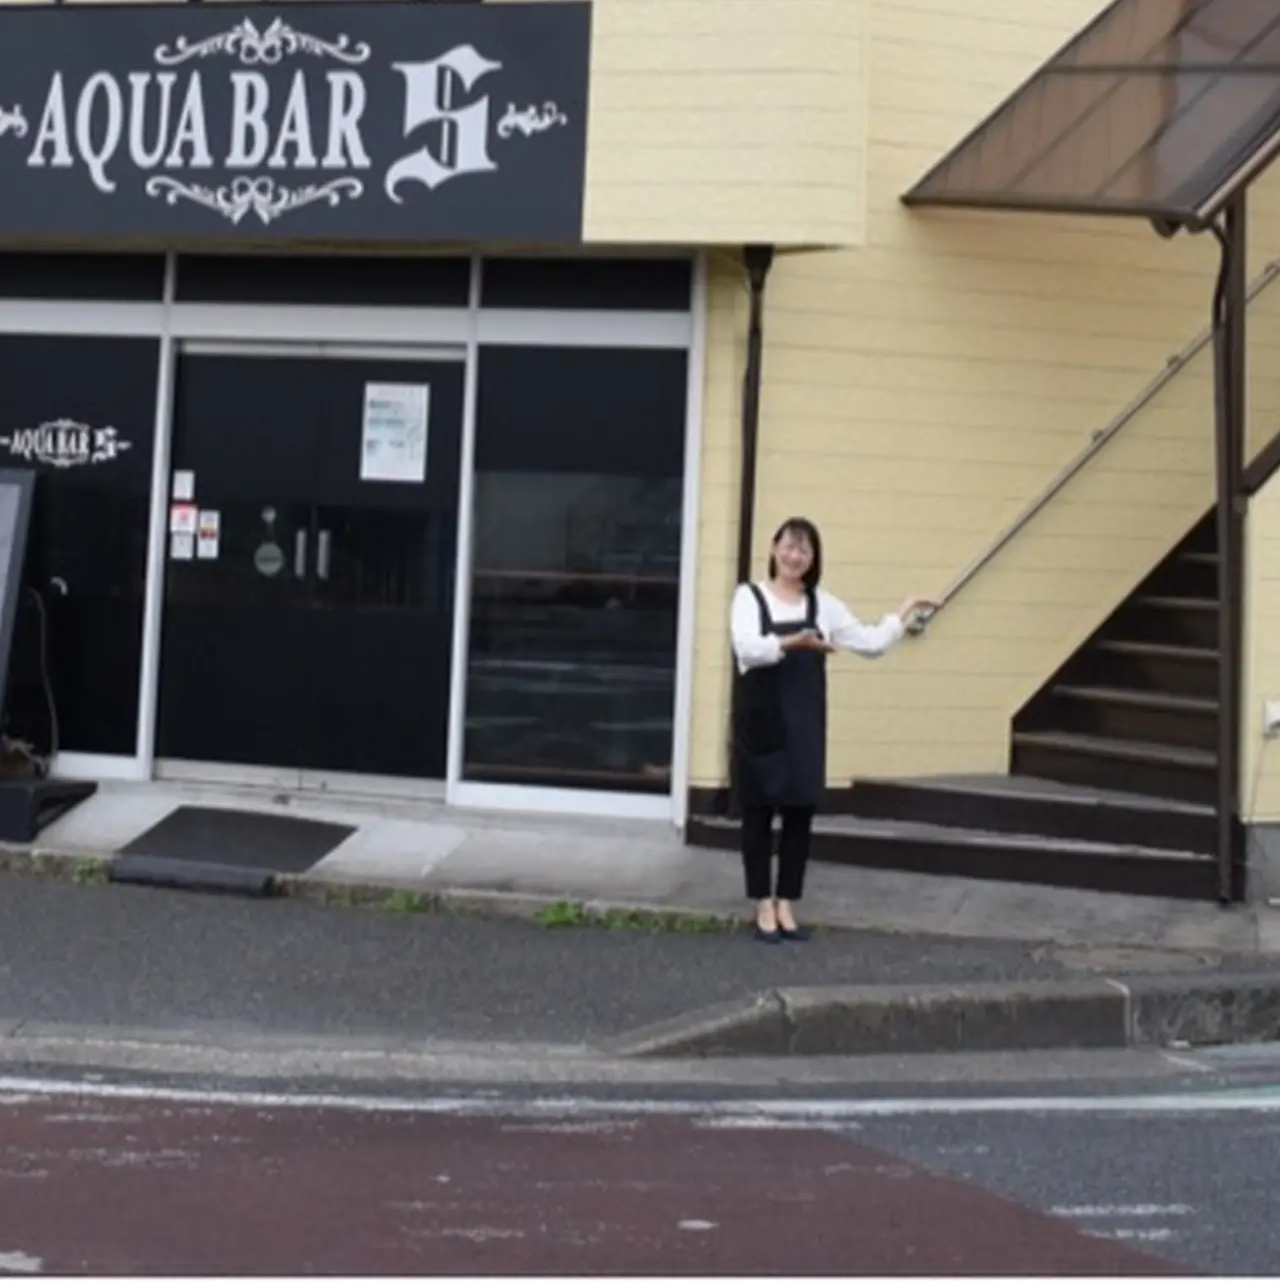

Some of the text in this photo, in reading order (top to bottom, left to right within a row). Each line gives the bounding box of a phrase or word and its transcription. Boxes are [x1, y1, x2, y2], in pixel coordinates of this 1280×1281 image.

[26, 44, 503, 204] AQUA BAR S
